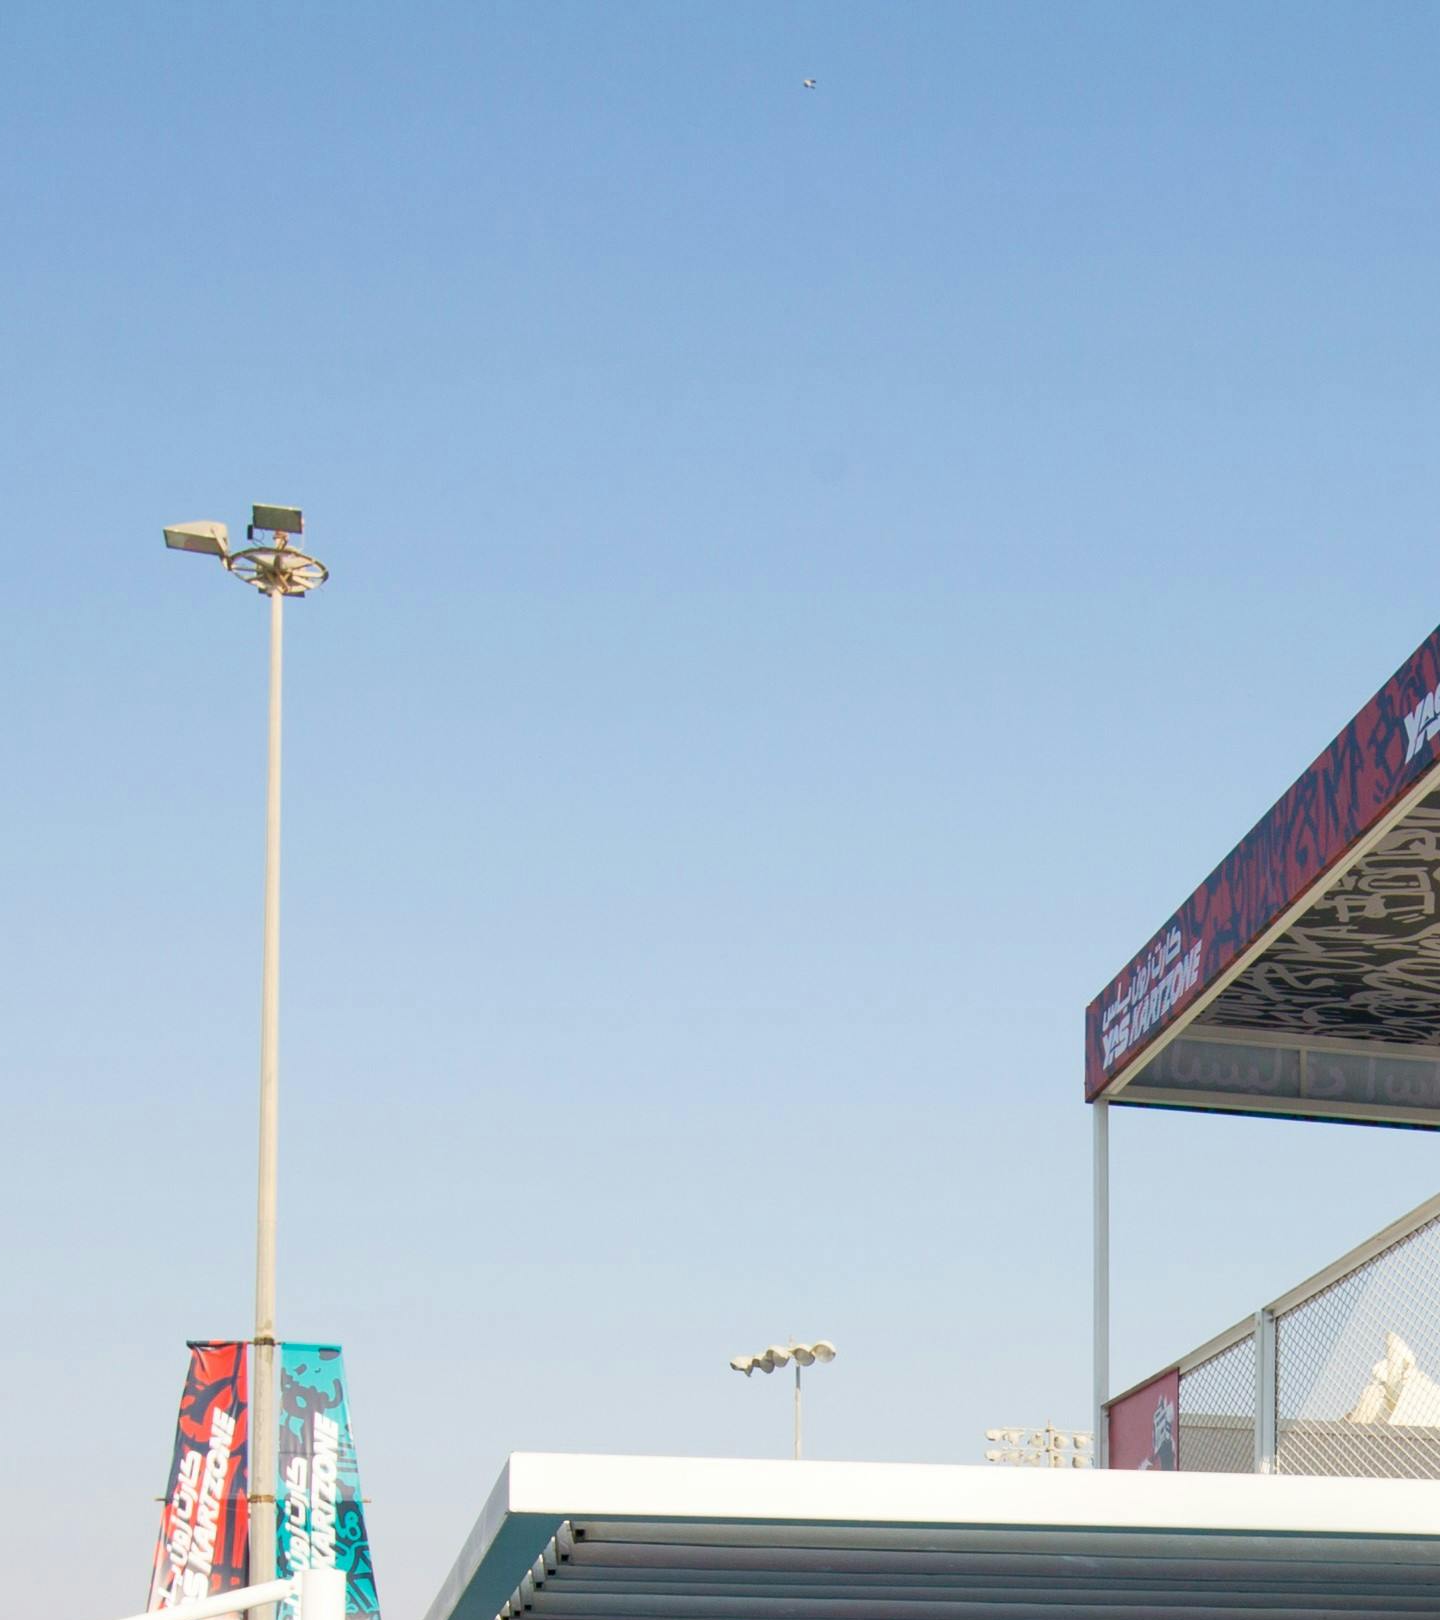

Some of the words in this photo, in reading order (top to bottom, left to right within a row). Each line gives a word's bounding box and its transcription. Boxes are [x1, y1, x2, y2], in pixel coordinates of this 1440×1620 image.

[1102, 1016, 1131, 1072] YAS
[189, 1406, 236, 1574] KARTZONE
[310, 1411, 339, 1570] KARTZONE
